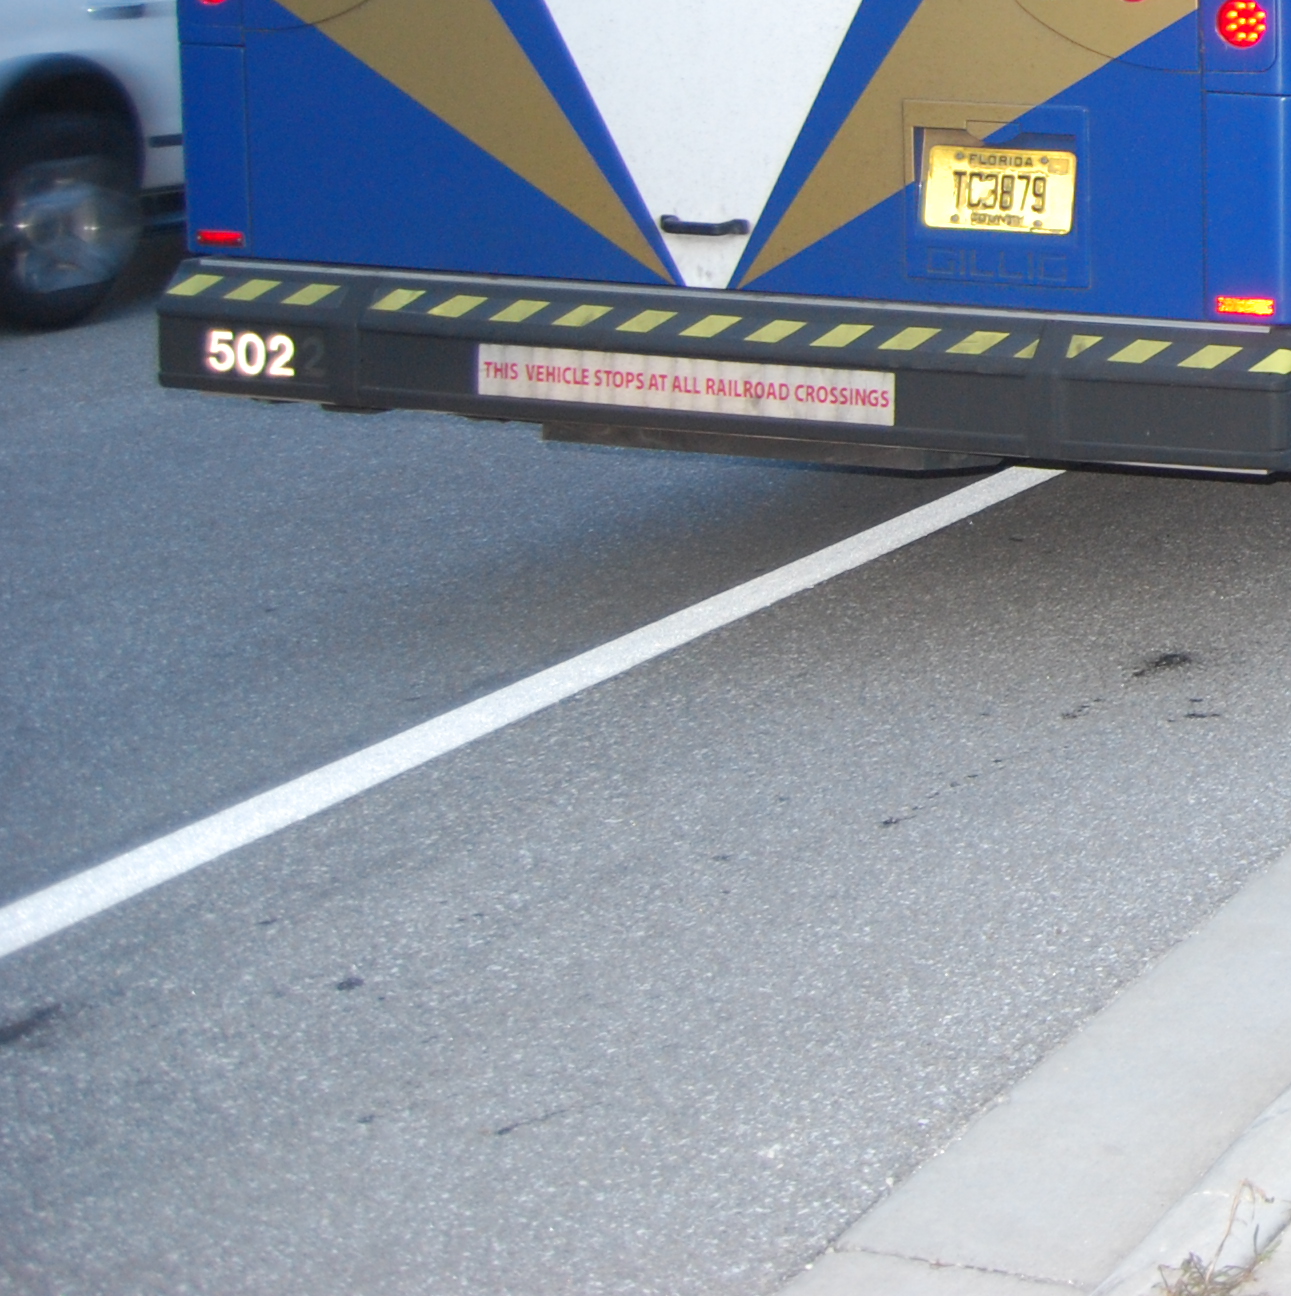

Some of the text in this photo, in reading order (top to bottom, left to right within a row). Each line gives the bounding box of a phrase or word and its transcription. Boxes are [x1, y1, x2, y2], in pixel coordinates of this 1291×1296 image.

[968, 153, 1033, 167] FLORIDA
[953, 170, 1046, 213] TC3879
[206, 328, 296, 377] 502
[484, 361, 890, 408] THIS VEHICLE STOPS AT ALL RAILROAD CROSSINGS
